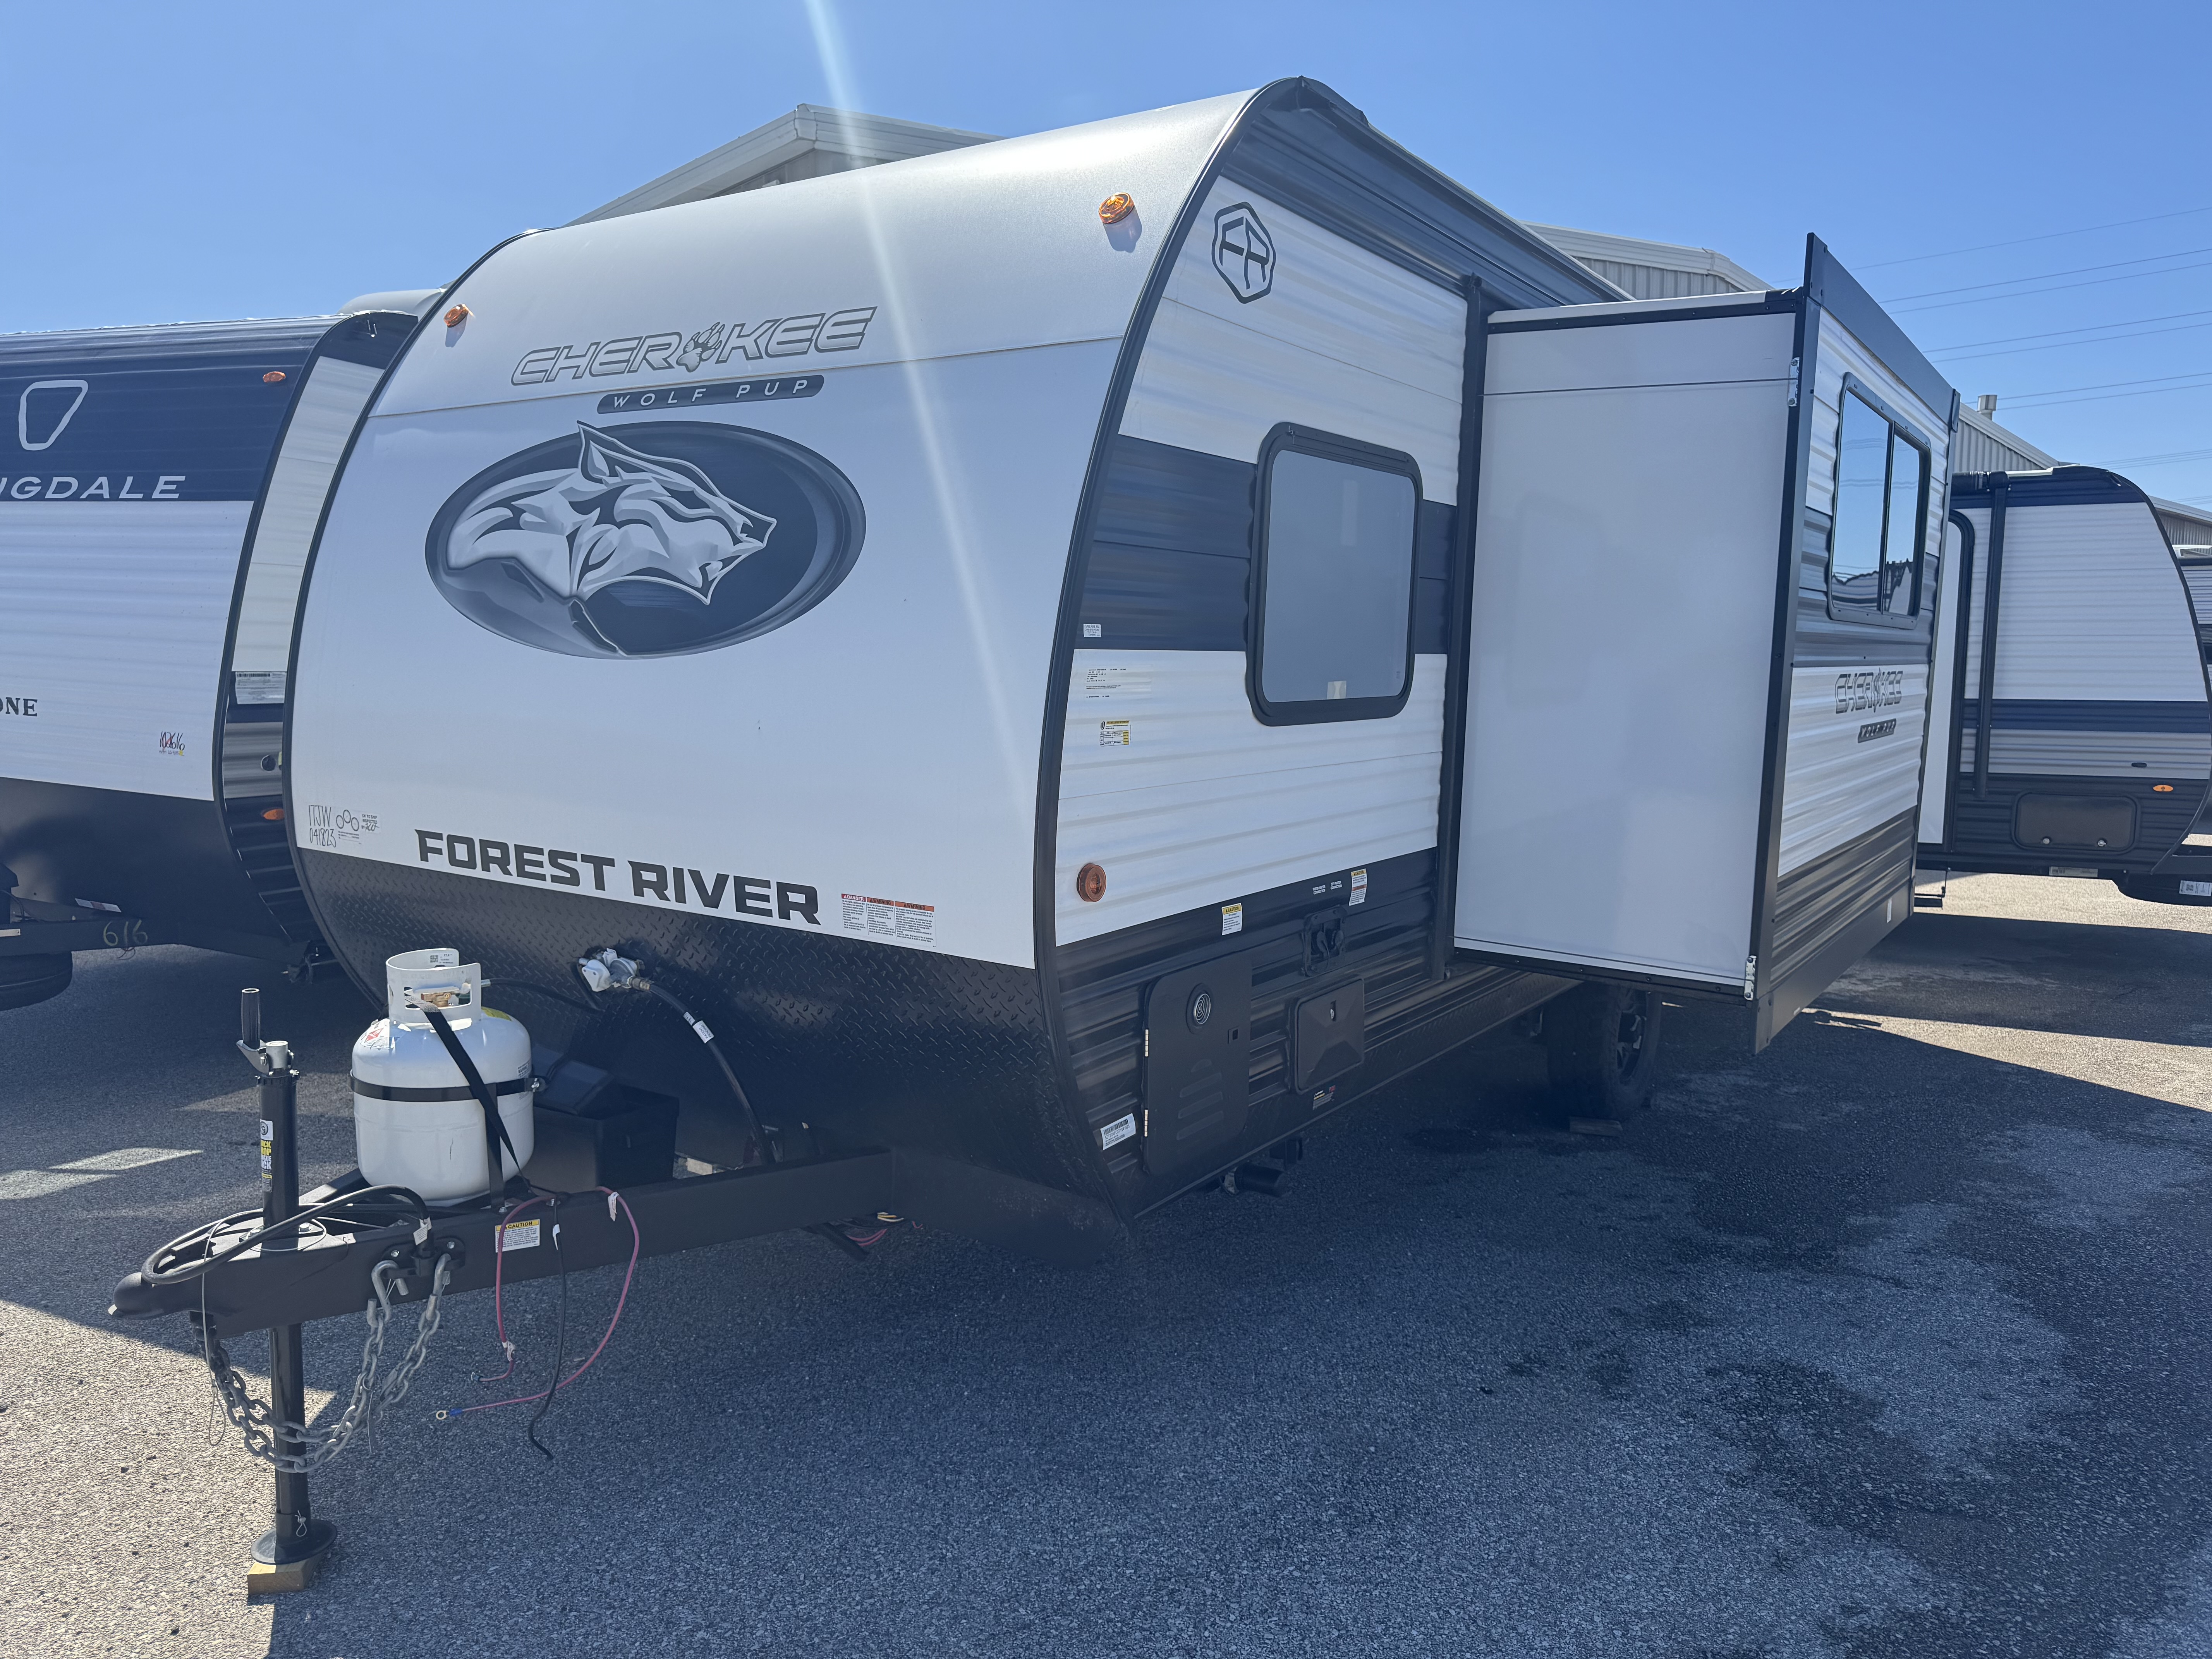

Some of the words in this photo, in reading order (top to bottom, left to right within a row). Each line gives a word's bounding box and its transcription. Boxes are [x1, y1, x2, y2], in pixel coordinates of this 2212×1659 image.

[613, 388, 706, 408] WOLF
[736, 380, 807, 398] PUP
[0, 476, 185, 499] GDALE
[0, 697, 38, 716] NE
[310, 828, 336, 848] 041823
[414, 829, 615, 891] FOREST
[627, 860, 821, 926] RIVER
[103, 919, 148, 947] 616
